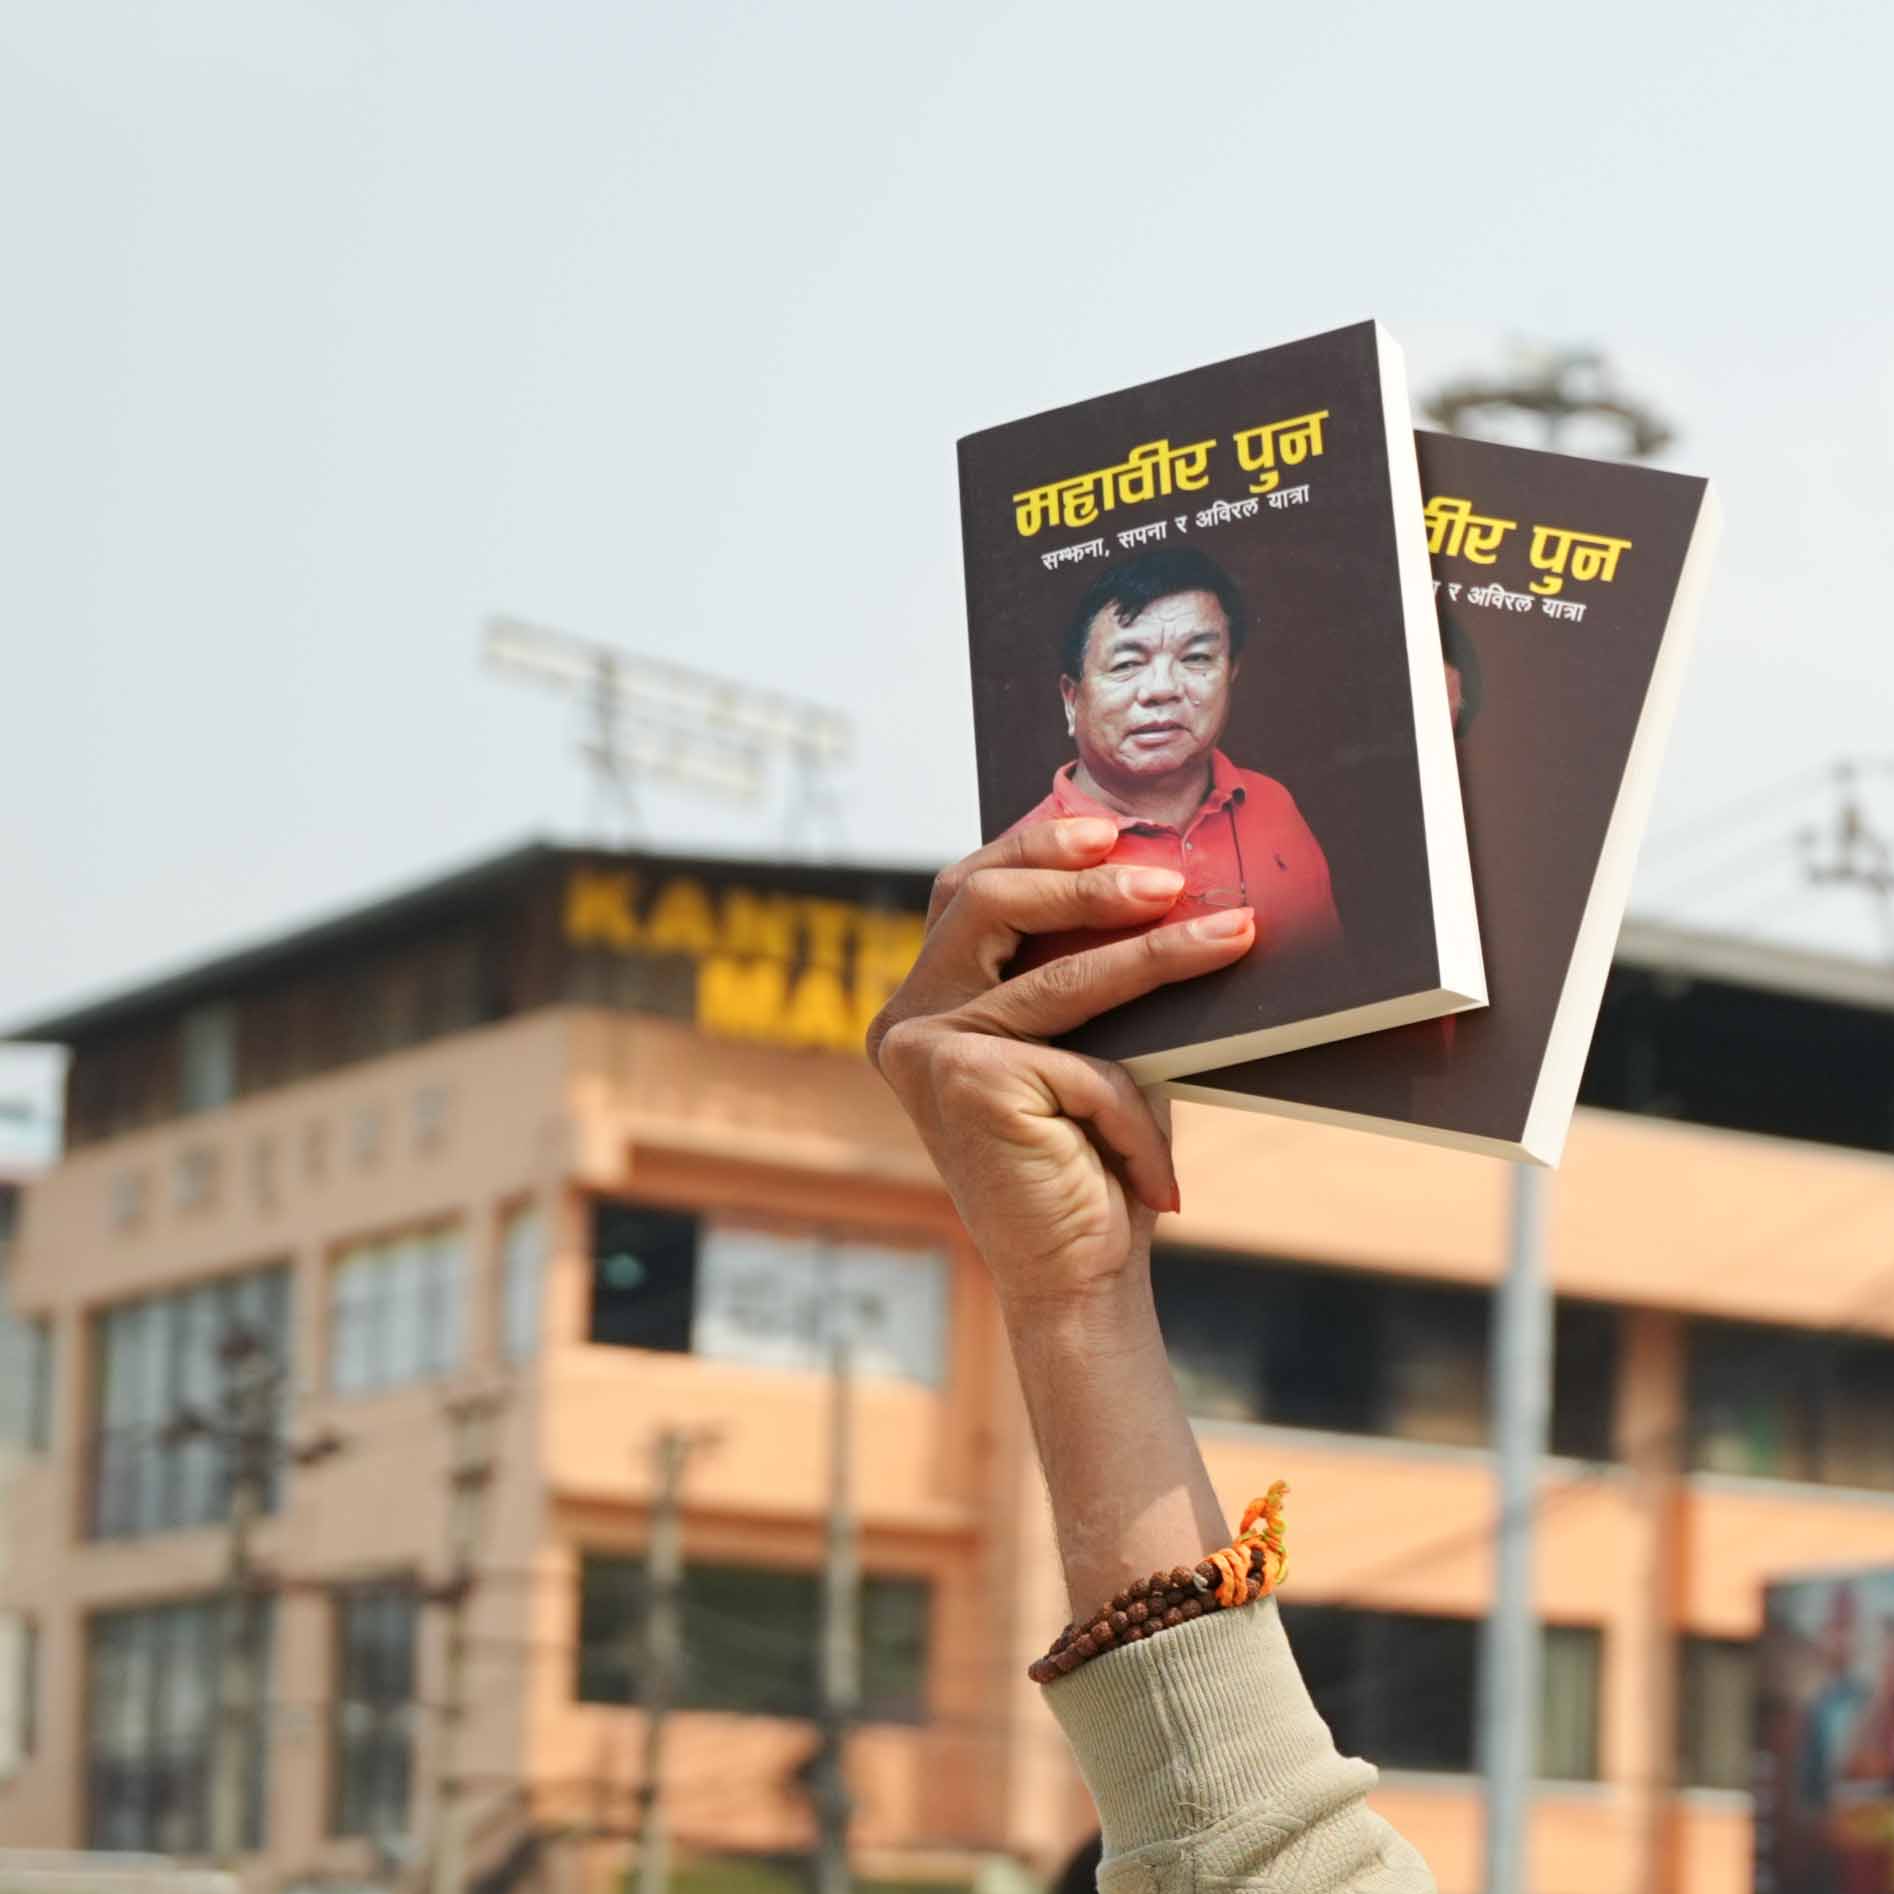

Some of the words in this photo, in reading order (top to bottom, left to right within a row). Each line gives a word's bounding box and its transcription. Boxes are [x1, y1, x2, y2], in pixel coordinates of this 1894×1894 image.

[1012, 438, 1217, 537] महावीर
[1233, 409, 1329, 494] पुन
[1117, 521, 1167, 549] सपना
[1175, 515, 1188, 533] र
[1195, 498, 1259, 529] अविरल
[1266, 483, 1310, 510] यात्रा
[1529, 524, 1632, 595] पुन
[1448, 581, 1462, 603] र
[1467, 582, 1534, 612] अविरल
[1542, 597, 1587, 623] यात्रा
